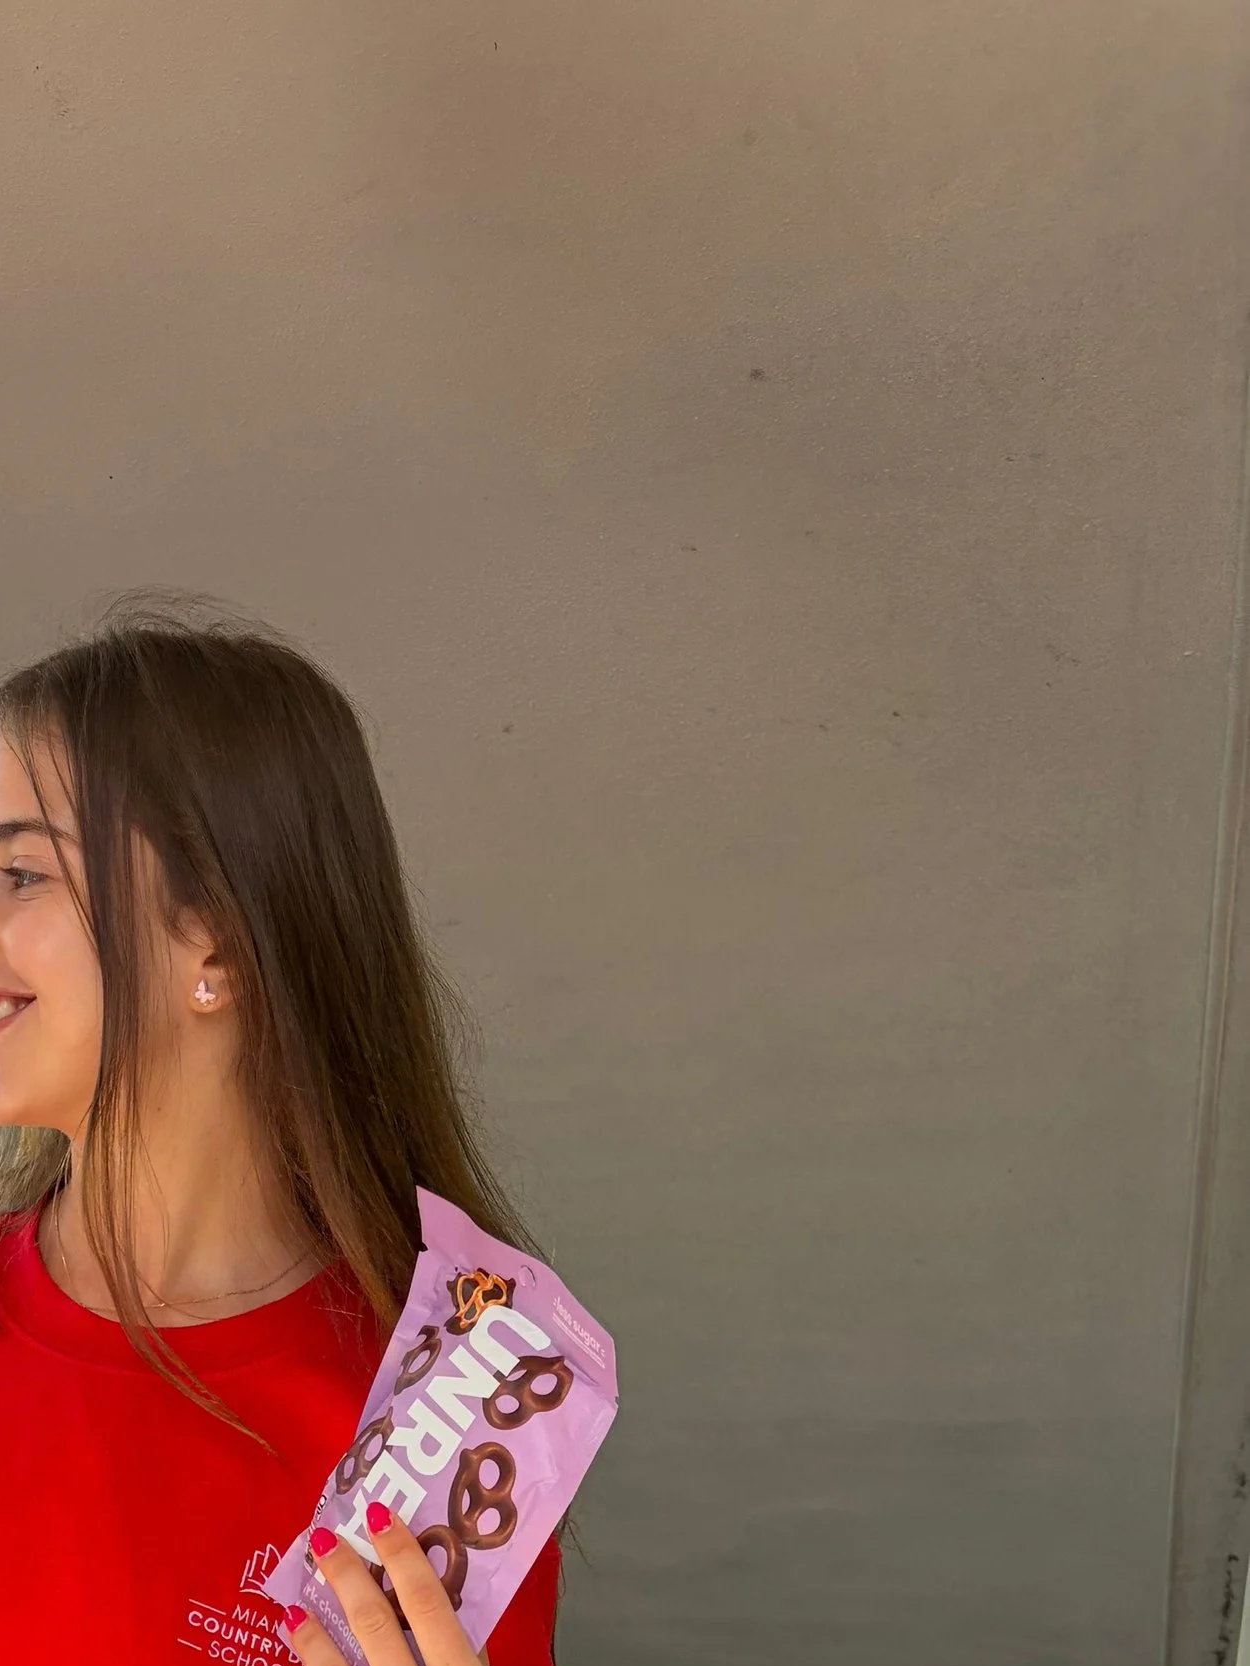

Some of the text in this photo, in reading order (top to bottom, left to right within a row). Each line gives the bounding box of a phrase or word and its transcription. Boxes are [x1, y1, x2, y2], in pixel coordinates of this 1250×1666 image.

[573, 1320, 601, 1353] sugar
[314, 1305, 552, 1586] UNREA
[187, 1610, 284, 1657] COUNTRY
[231, 1603, 279, 1634] MIA
[319, 1599, 365, 1660] chocolate
